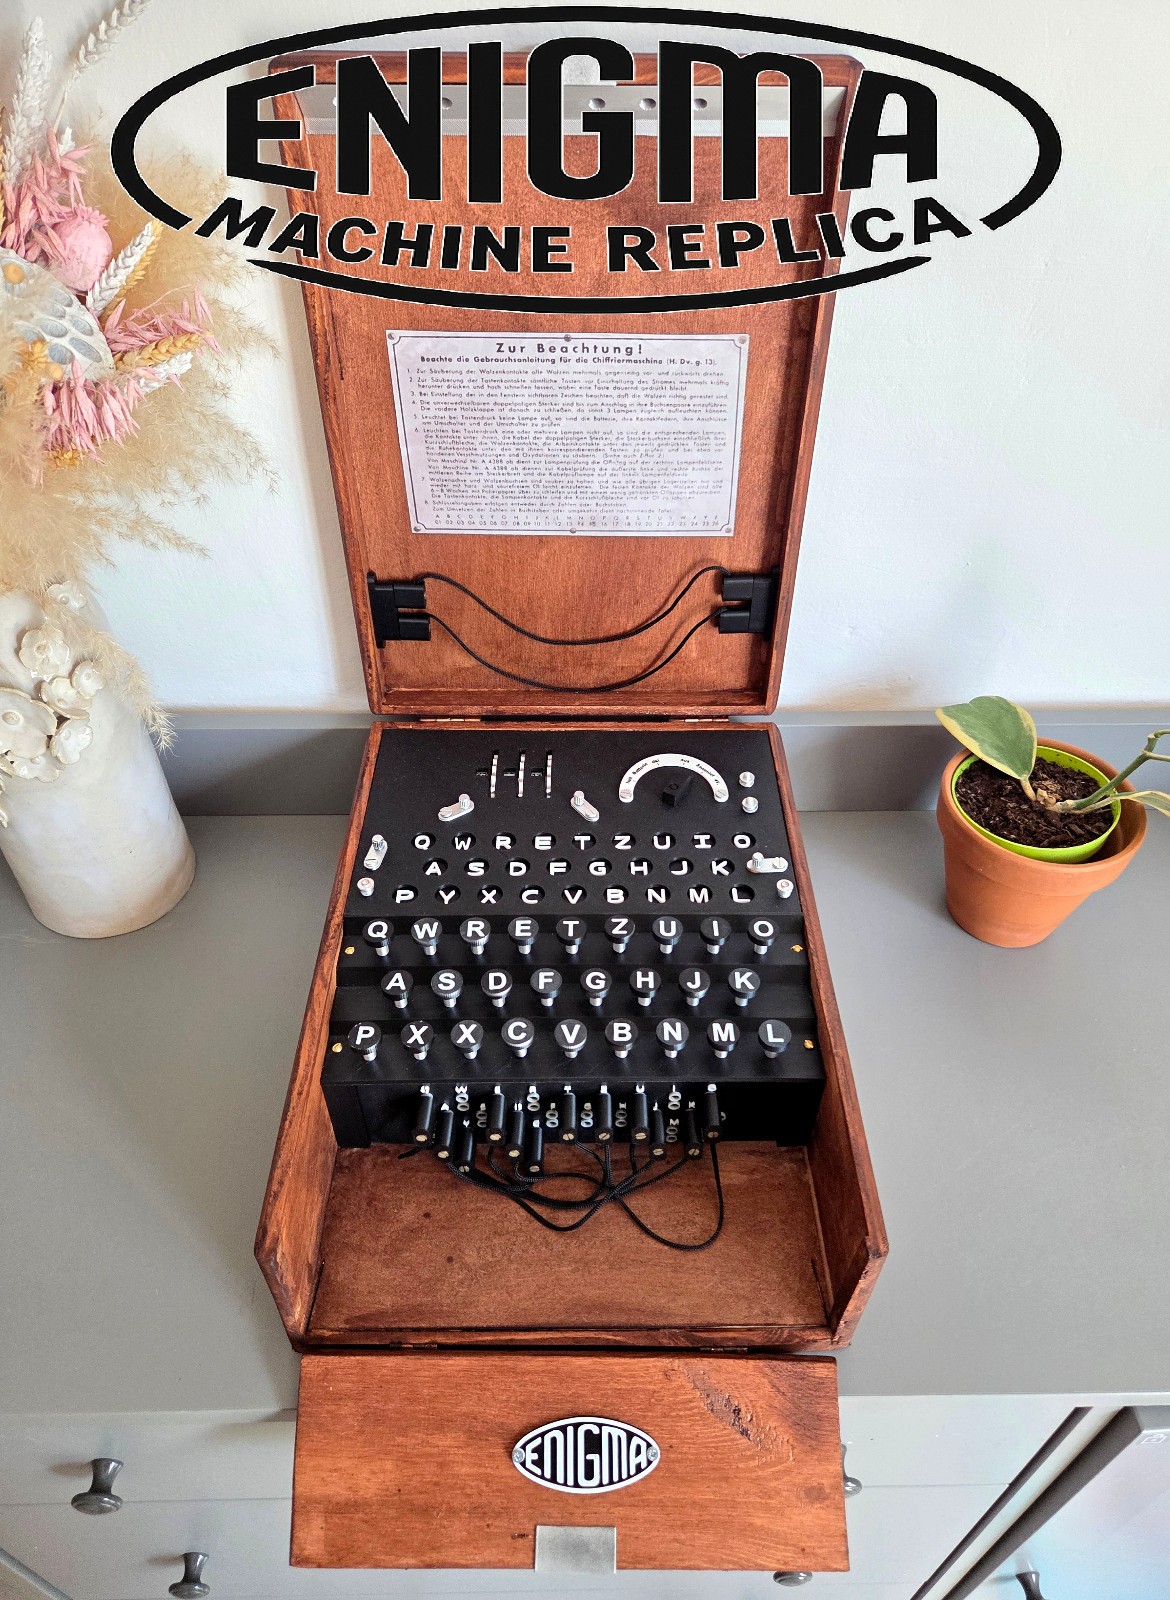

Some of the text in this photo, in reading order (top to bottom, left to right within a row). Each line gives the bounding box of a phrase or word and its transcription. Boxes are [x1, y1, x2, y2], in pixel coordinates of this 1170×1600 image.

[495, 341, 642, 356] Zur Beachtung!
[419, 354, 453, 362] Beachte
[473, 355, 555, 365] Gebrauchsanleitung
[559, 356, 571, 364] für
[574, 356, 588, 364] die
[592, 356, 663, 365] Chiffriermaschine
[415, 835, 750, 850] Q W R E T Z U I O
[425, 861, 729, 876] A S D F G H J K
[396, 888, 751, 904] P Y X C V B N M L
[368, 919, 773, 939] Q W R E T Z U I O
[386, 971, 754, 990] A S D F G H J K
[356, 1022, 784, 1044] P X X C V B N M L
[525, 1423, 648, 1487] ENIGMA
